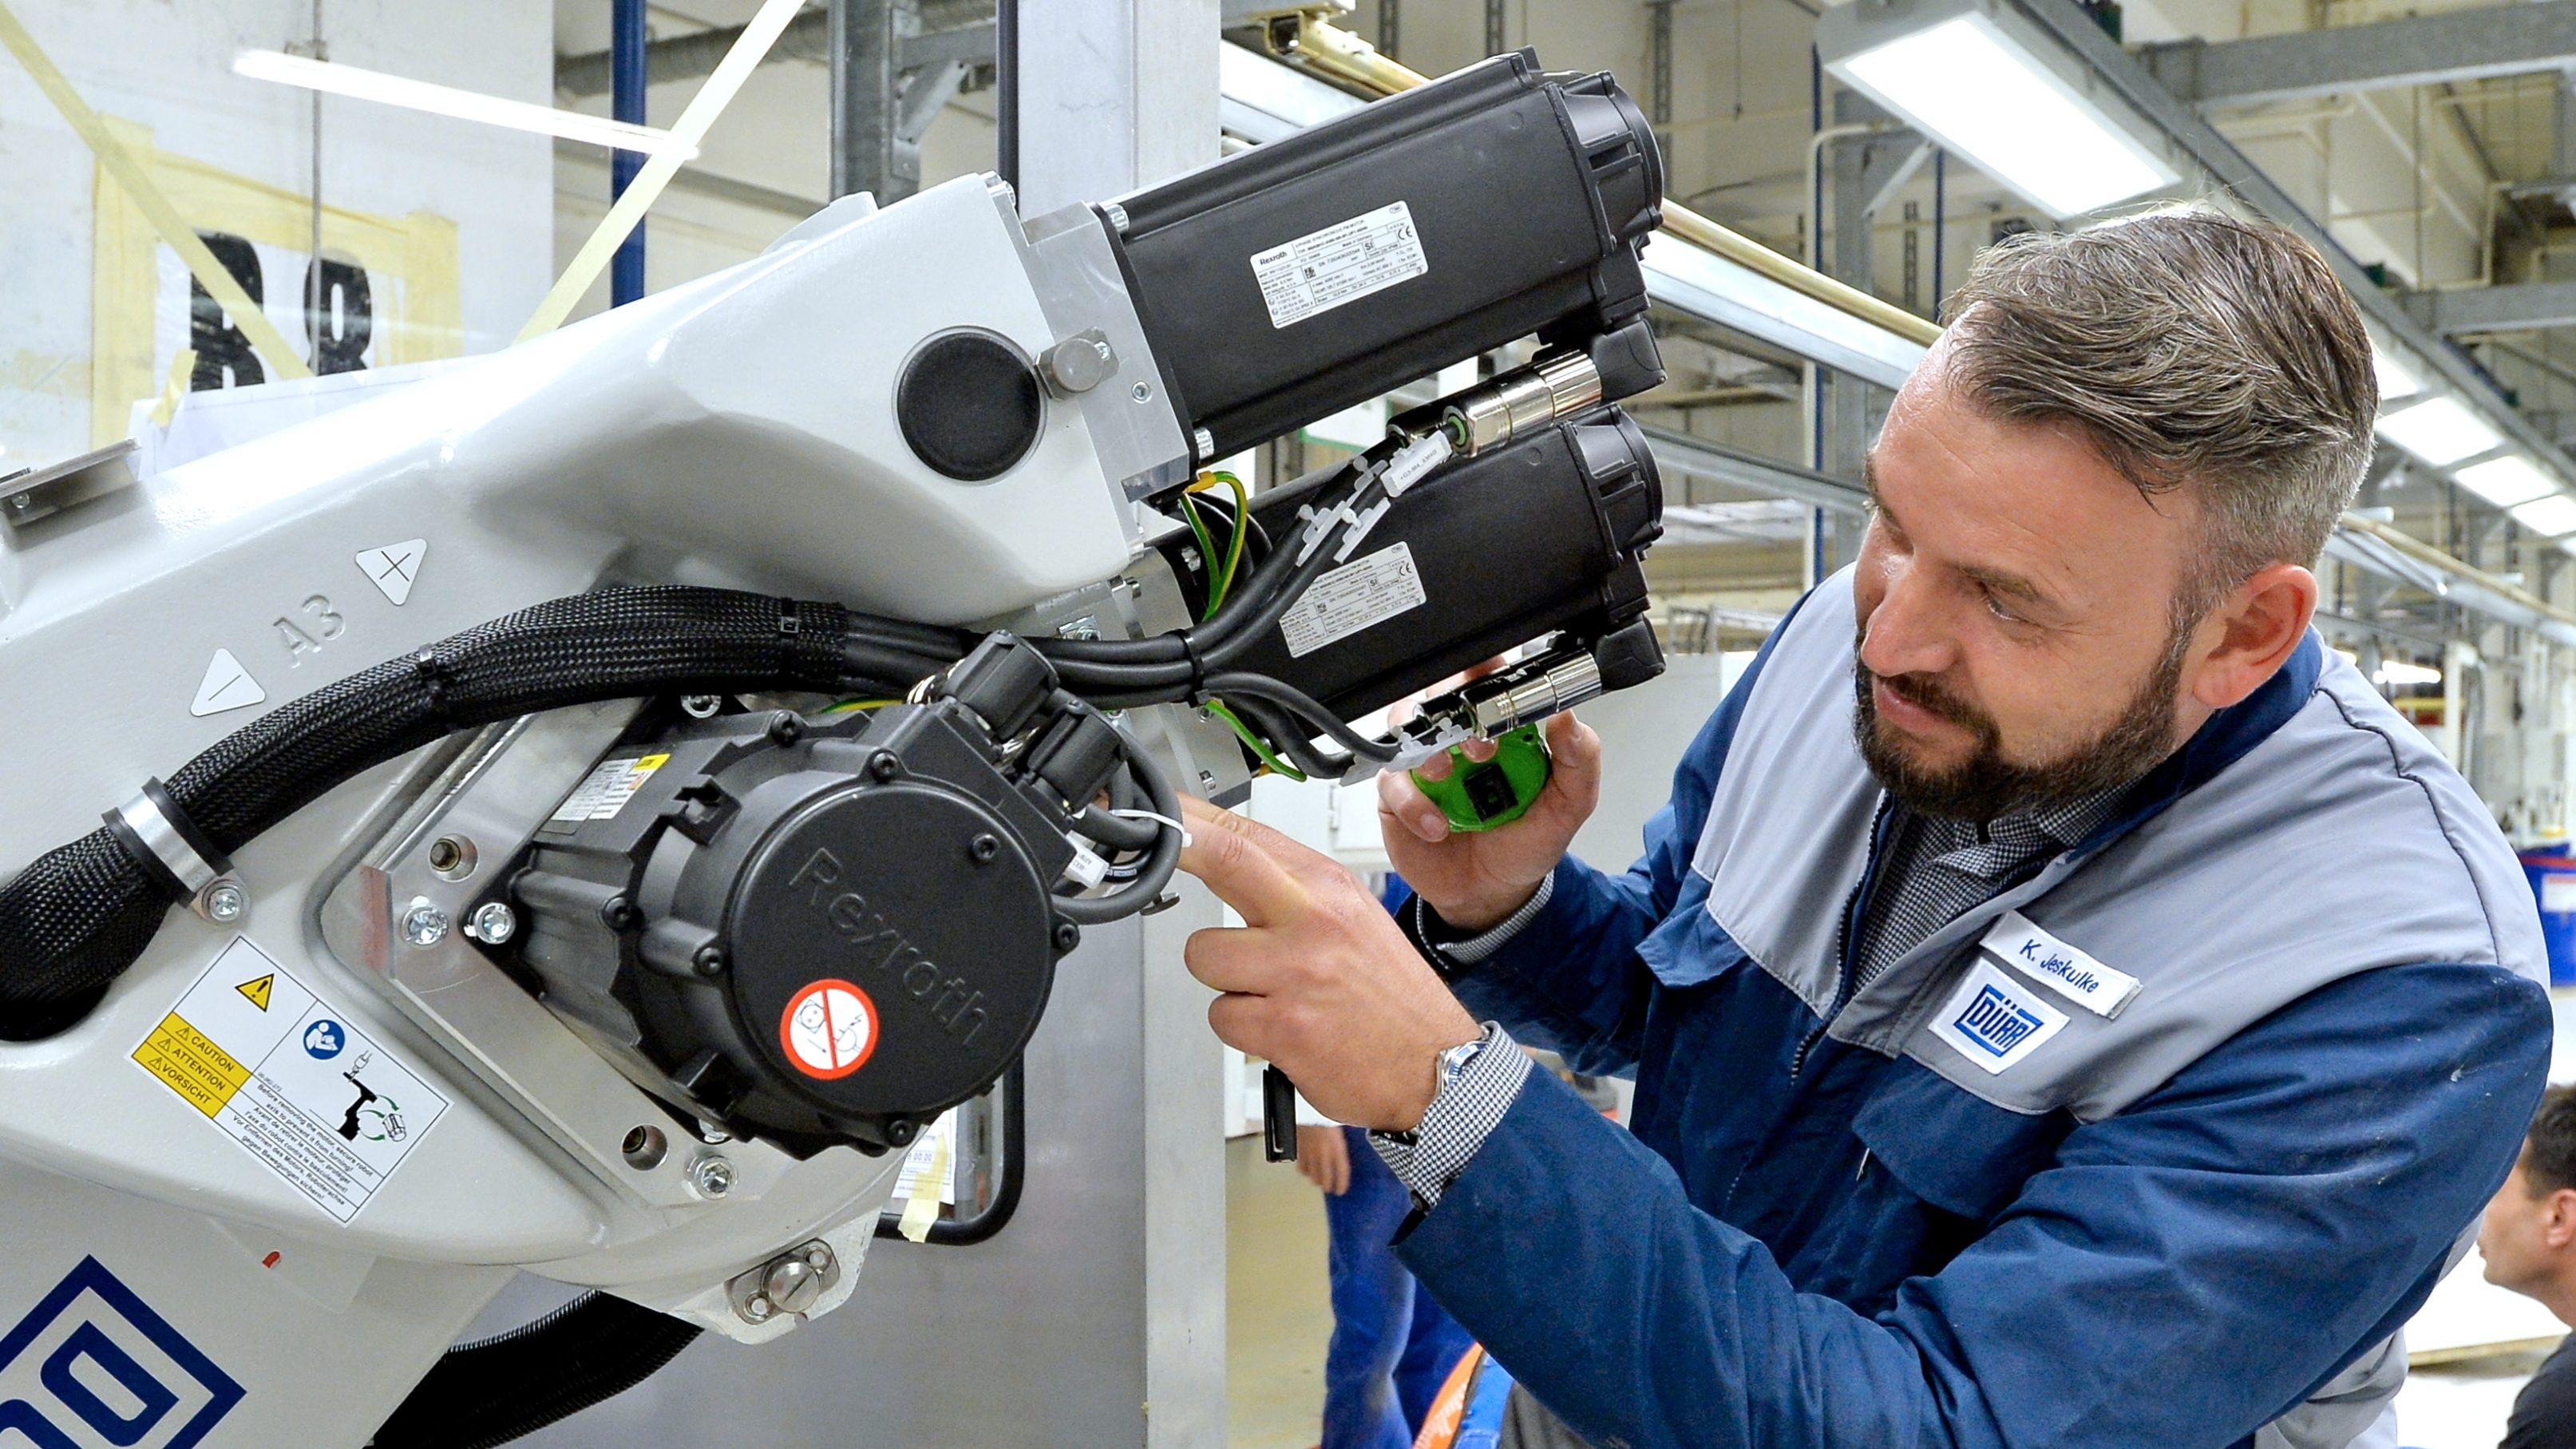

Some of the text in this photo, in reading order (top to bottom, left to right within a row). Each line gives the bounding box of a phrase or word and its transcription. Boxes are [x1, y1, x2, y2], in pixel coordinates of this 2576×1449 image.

[1259, 251, 1288, 266] Rexroth
[273, 594, 346, 669] A3
[789, 847, 988, 1045] Rexroth
[2019, 939, 2099, 993] K. Jeskulke
[1965, 995, 2032, 1050] DÜRR
[171, 1047, 226, 1091] ATTENTION
[190, 1035, 235, 1072] CAUTION
[161, 1062, 212, 1104] VORSICHT
[252, 1107, 272, 1122] Avant
[278, 1126, 299, 1142] retirer
[256, 1083, 278, 1102] Before
[277, 1100, 307, 1126] removing
[305, 1122, 317, 1132] the
[334, 1146, 356, 1164] secure
[355, 1162, 374, 1177] robot
[258, 1122, 268, 1131] du
[267, 1129, 285, 1144] robot
[283, 1142, 303, 1158] contre
[265, 1103, 279, 1114] axis
[284, 1118, 311, 1138] prevent
[314, 1139, 329, 1154] from
[232, 1114, 244, 1126] Vor
[243, 1123, 272, 1149] Entfernen
[271, 1146, 283, 1158] des
[305, 1171, 345, 1206] Roboterachse
[240, 1134, 262, 1151] gegen
[260, 1148, 299, 1182] Bewegungen
